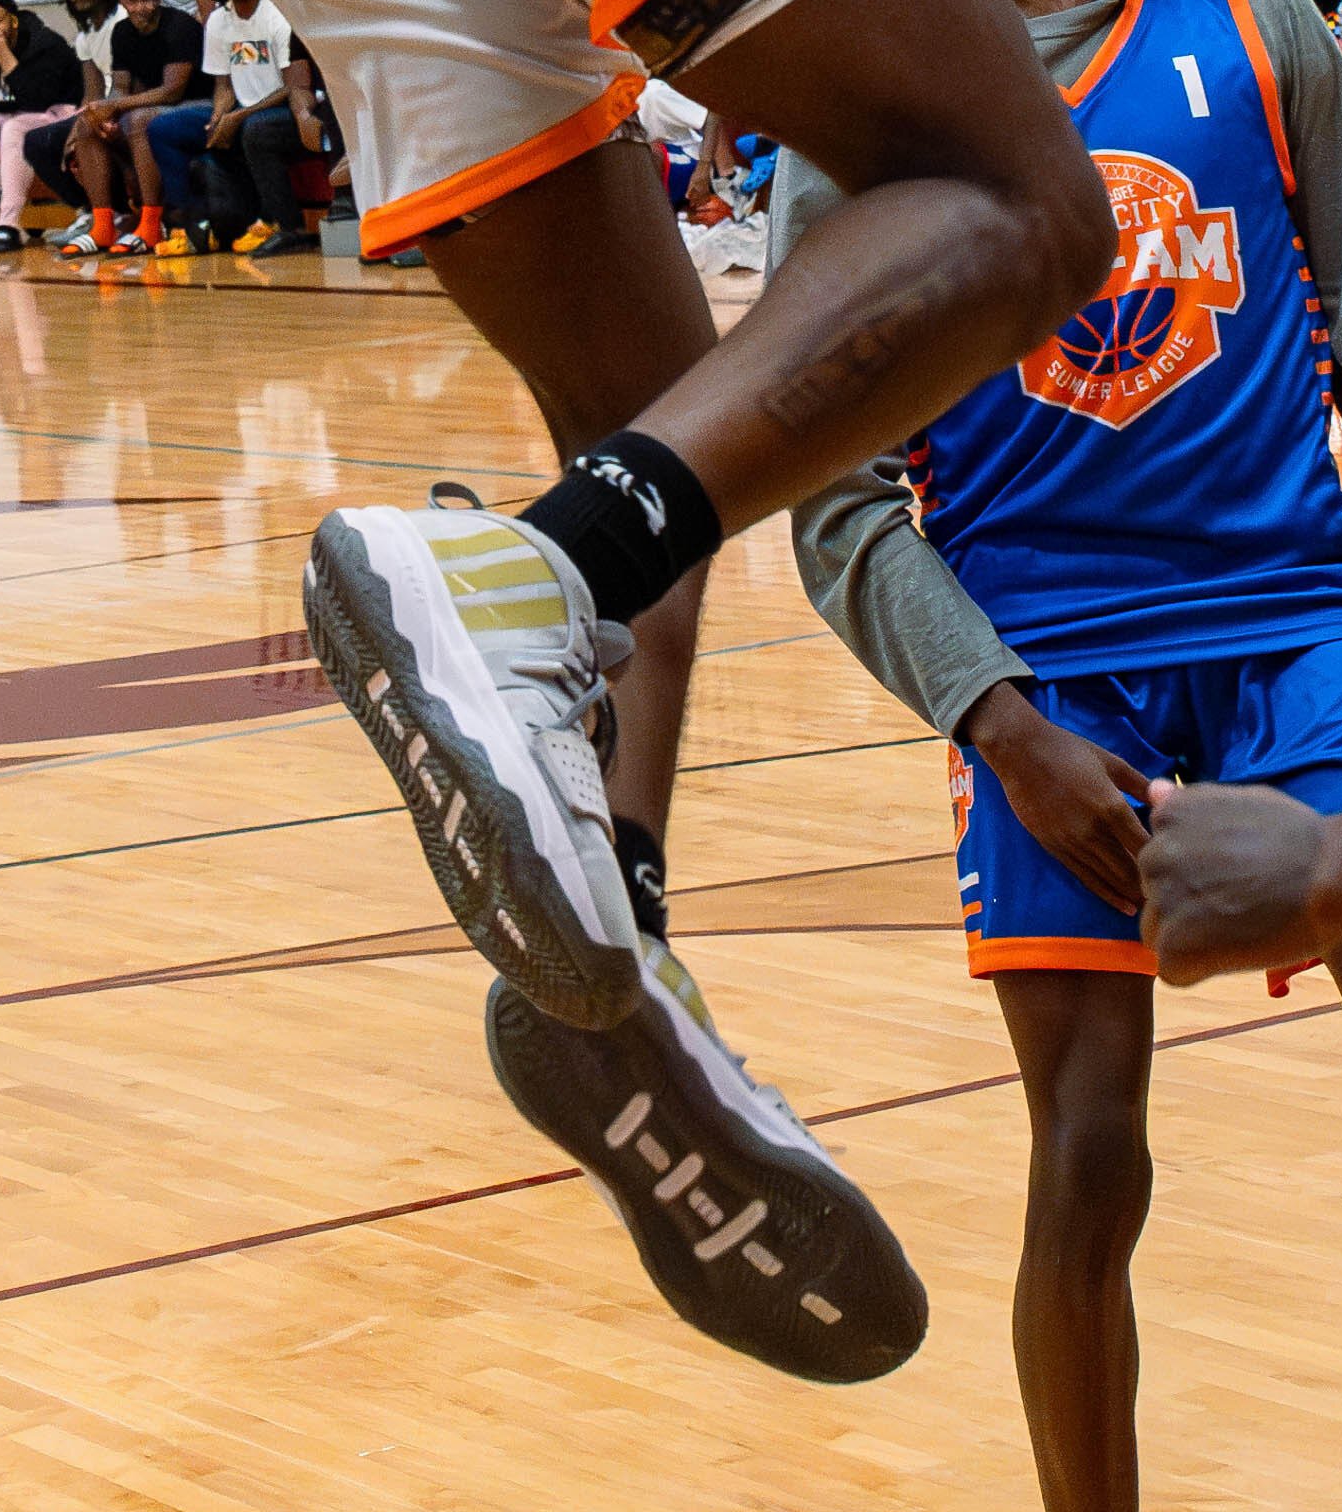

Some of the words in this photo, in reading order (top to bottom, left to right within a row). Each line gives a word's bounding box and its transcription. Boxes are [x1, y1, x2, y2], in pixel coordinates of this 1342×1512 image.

[1171, 54, 1211, 119] 1
[1112, 191, 1185, 231] CITY
[1120, 330, 1195, 397] LEAGUE
